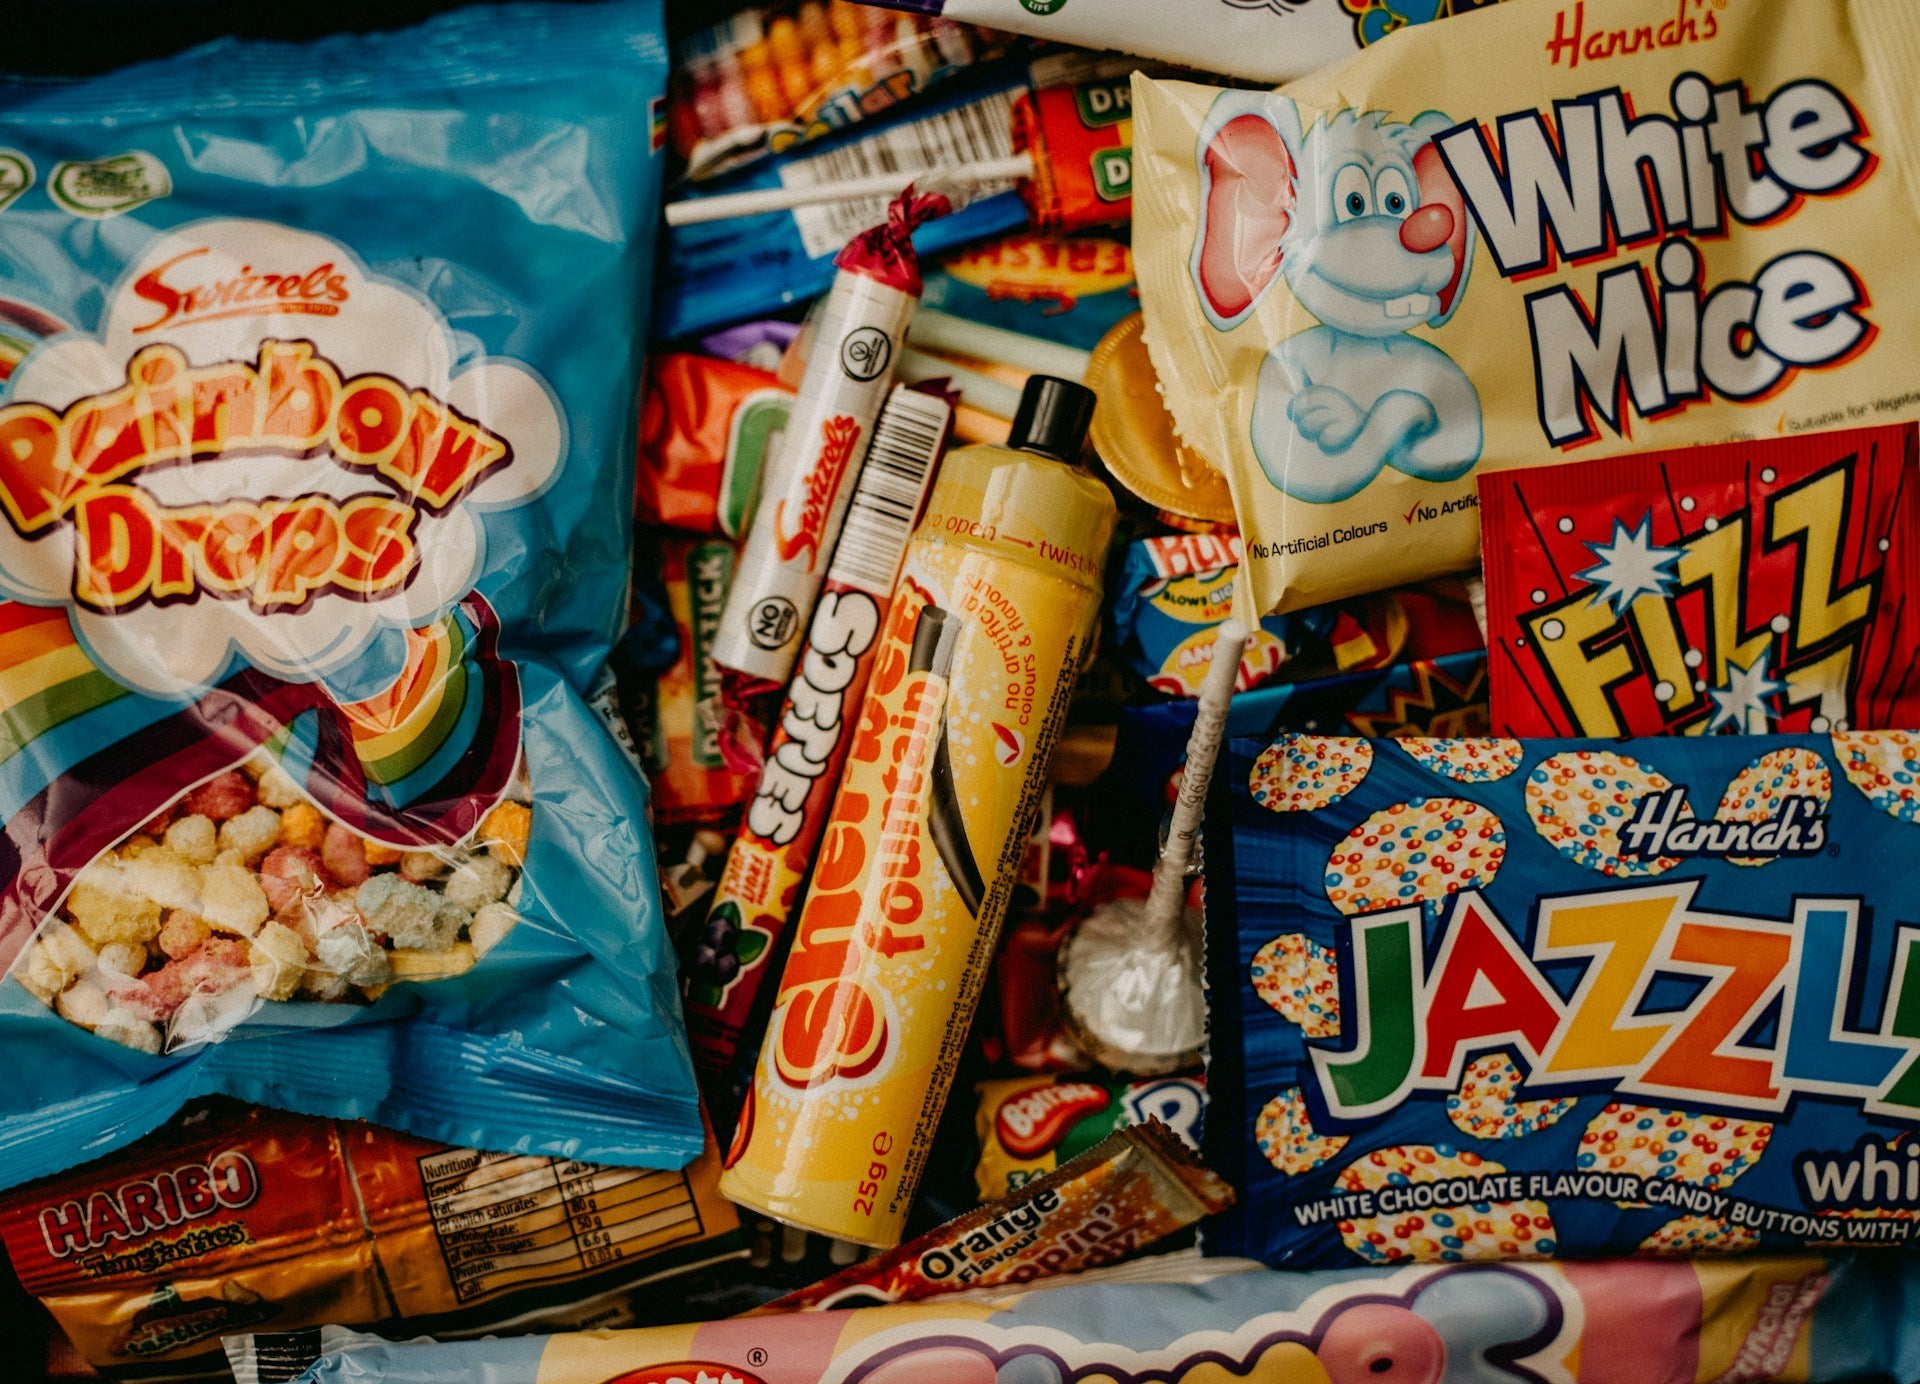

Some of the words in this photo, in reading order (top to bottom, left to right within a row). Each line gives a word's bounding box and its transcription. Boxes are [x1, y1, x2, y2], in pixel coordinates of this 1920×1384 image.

[1028, 1, 1051, 12] LIFE
[1545, 0, 1718, 69] Hannah's
[1433, 71, 1878, 279] White
[132, 247, 349, 334] Swizzels
[1524, 237, 1878, 449] Mice
[0, 338, 513, 540] Rainbow
[1847, 402, 1868, 420] for
[774, 415, 857, 573] Swizzels
[1418, 507, 1437, 523] No
[76, 488, 420, 615] Drops
[945, 516, 996, 542] open
[1039, 540, 1086, 573] twist
[1253, 543, 1269, 560] No
[1271, 532, 1331, 557] Artificial
[1333, 521, 1388, 545] Colours
[756, 603, 780, 637] NO
[962, 592, 1021, 676] artificial
[963, 571, 1025, 633] flavours
[1018, 634, 1032, 648] &
[1005, 682, 1021, 710] no
[1018, 653, 1036, 727] colours
[862, 678, 941, 960] fountain
[1626, 787, 1826, 856] Hannah's
[743, 854, 764, 905] FRUIT
[889, 1203, 897, 1212] If
[894, 1175, 907, 1201] you
[904, 1149, 914, 1170] are
[911, 1121, 922, 1144] not
[919, 1064, 942, 1117] entirely
[936, 1002, 959, 1060] satisfied
[955, 968, 970, 998] with
[966, 938, 979, 964] this
[976, 876, 1001, 934] product,
[995, 827, 1015, 871] please
[1011, 780, 1028, 822] return
[1025, 752, 1037, 774] the
[1034, 716, 1049, 748] pack
[1061, 635, 1074, 664] with
[918, 1132, 926, 1146] of
[923, 1091, 939, 1129] when
[937, 1062, 949, 1087] and
[946, 1016, 963, 1058] where
[966, 973, 976, 998] was
[1006, 793, 1033, 864] Tangerine
[1029, 686, 1068, 789] Confectionery
[38, 1150, 258, 1258] HARIBO
[486, 1196, 539, 1221] saturates:
[853, 1161, 888, 1217] 25g
[1293, 1193, 1373, 1228] WHITE
[1378, 1175, 1523, 1212] CHOCOLATE
[1529, 1173, 1638, 1199] FLAVOUR
[1644, 1181, 1728, 1217] CANDY
[1730, 1203, 1839, 1239] BUTTONS
[1847, 1220, 1909, 1240] WITH
[79, 1221, 249, 1277] Tangfastics
[920, 1188, 1061, 1281] Orange
[956, 1229, 1039, 1284] Flavour
